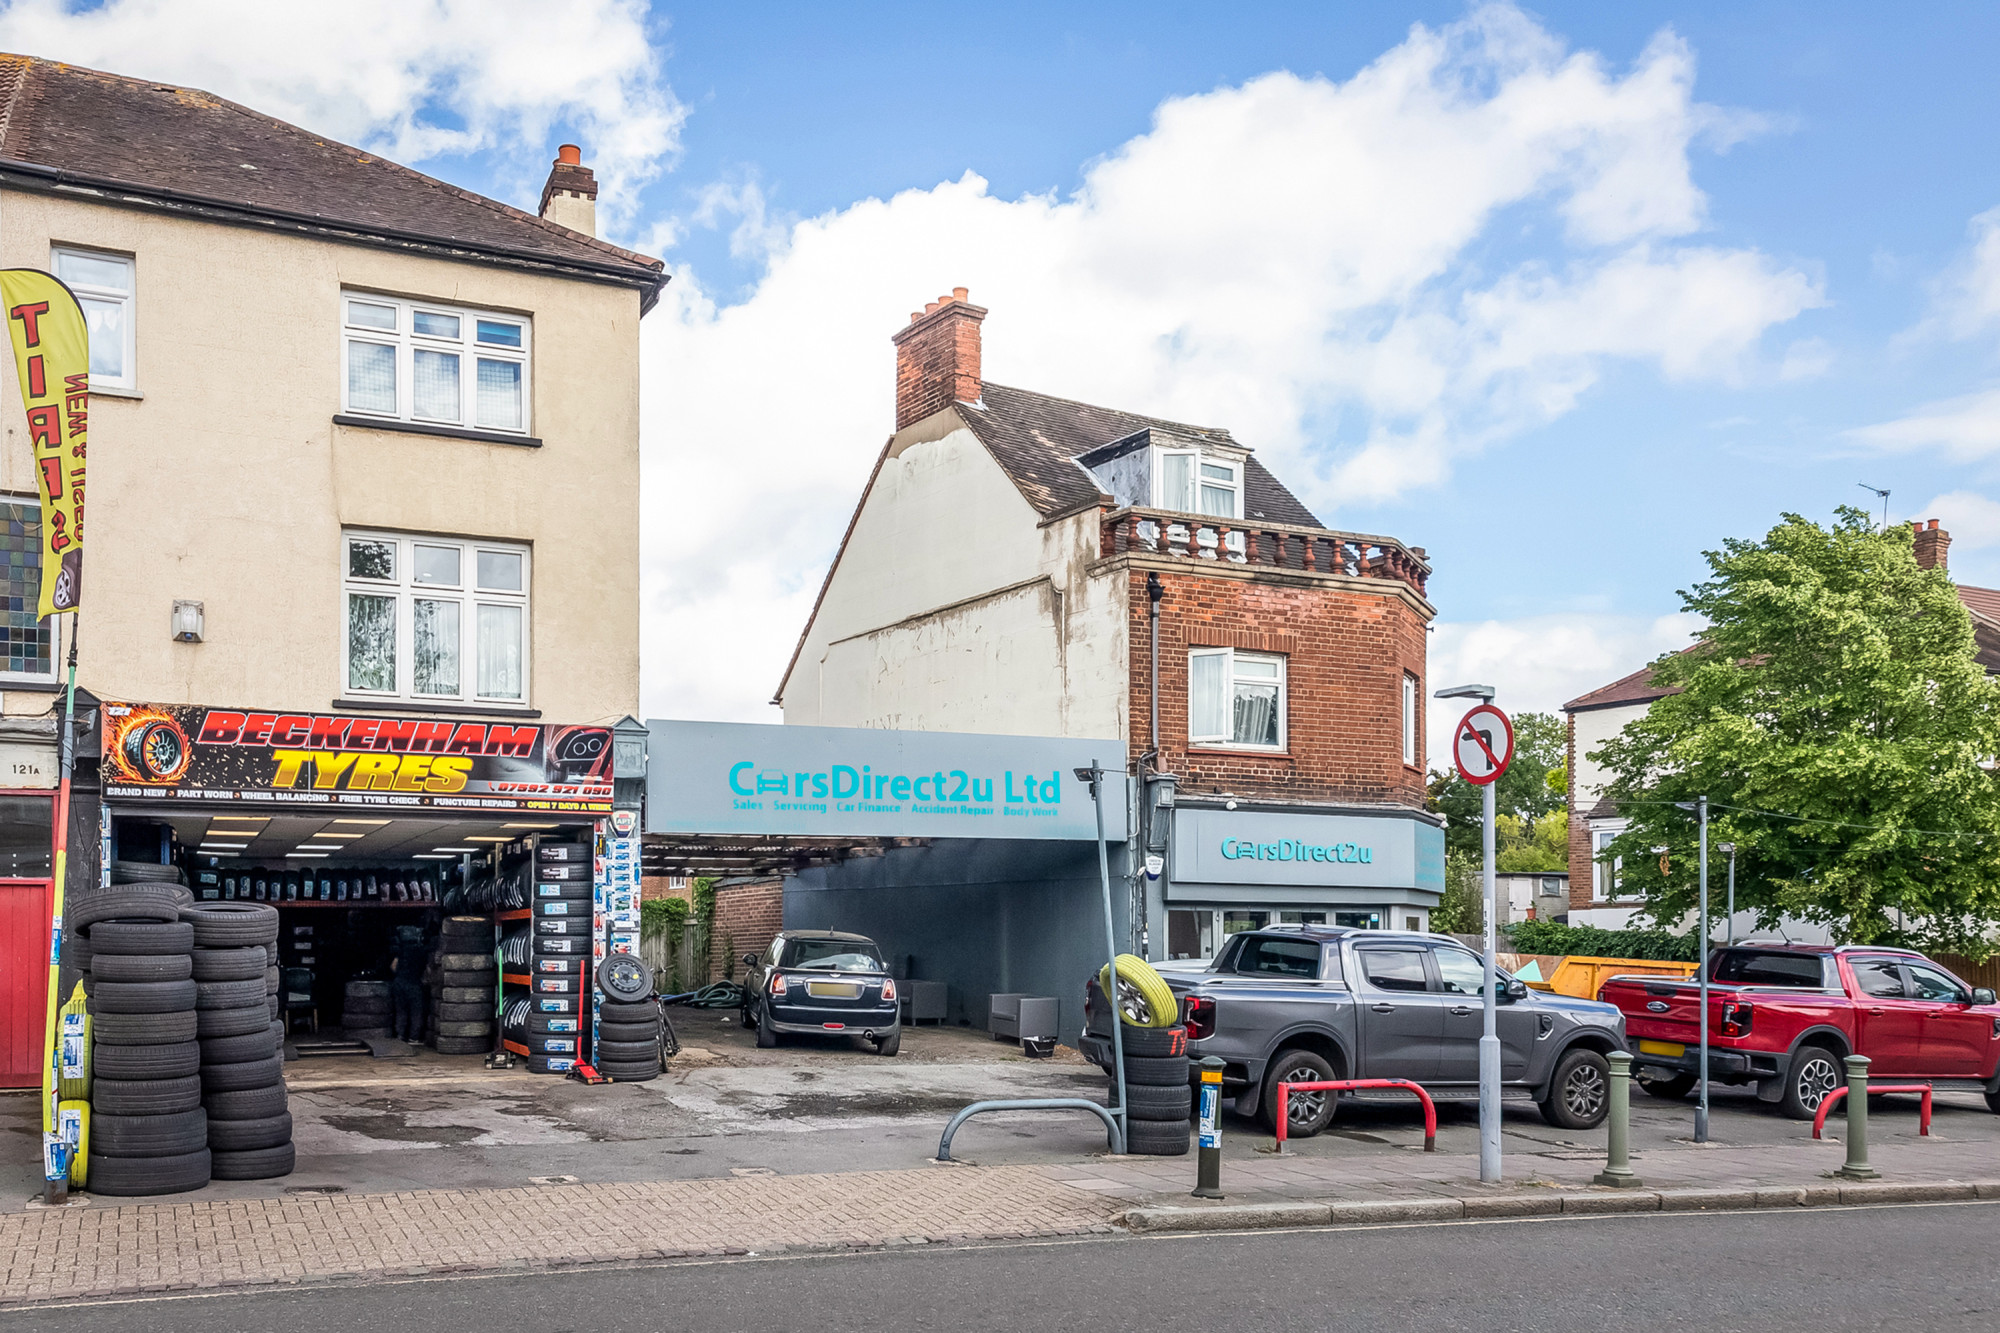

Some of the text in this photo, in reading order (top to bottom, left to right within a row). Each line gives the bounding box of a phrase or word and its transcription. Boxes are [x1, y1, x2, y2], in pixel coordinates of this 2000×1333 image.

[108, 706, 131, 716] 121
[196, 711, 540, 758] BECKENHAM
[272, 749, 474, 793] TYRES
[106, 787, 613, 812] BRAND NEW PART WORN WHEEL BALANCING FREE TYRE CHECK PUNCTURE REPAIRS OPEN 7 DAYS A WEEK
[498, 782, 612, 796] 07592 921 090
[1005, 770, 1061, 804] Ltd
[733, 799, 1059, 818] Sales Servicing Car Finance Accident Repair Body Work
